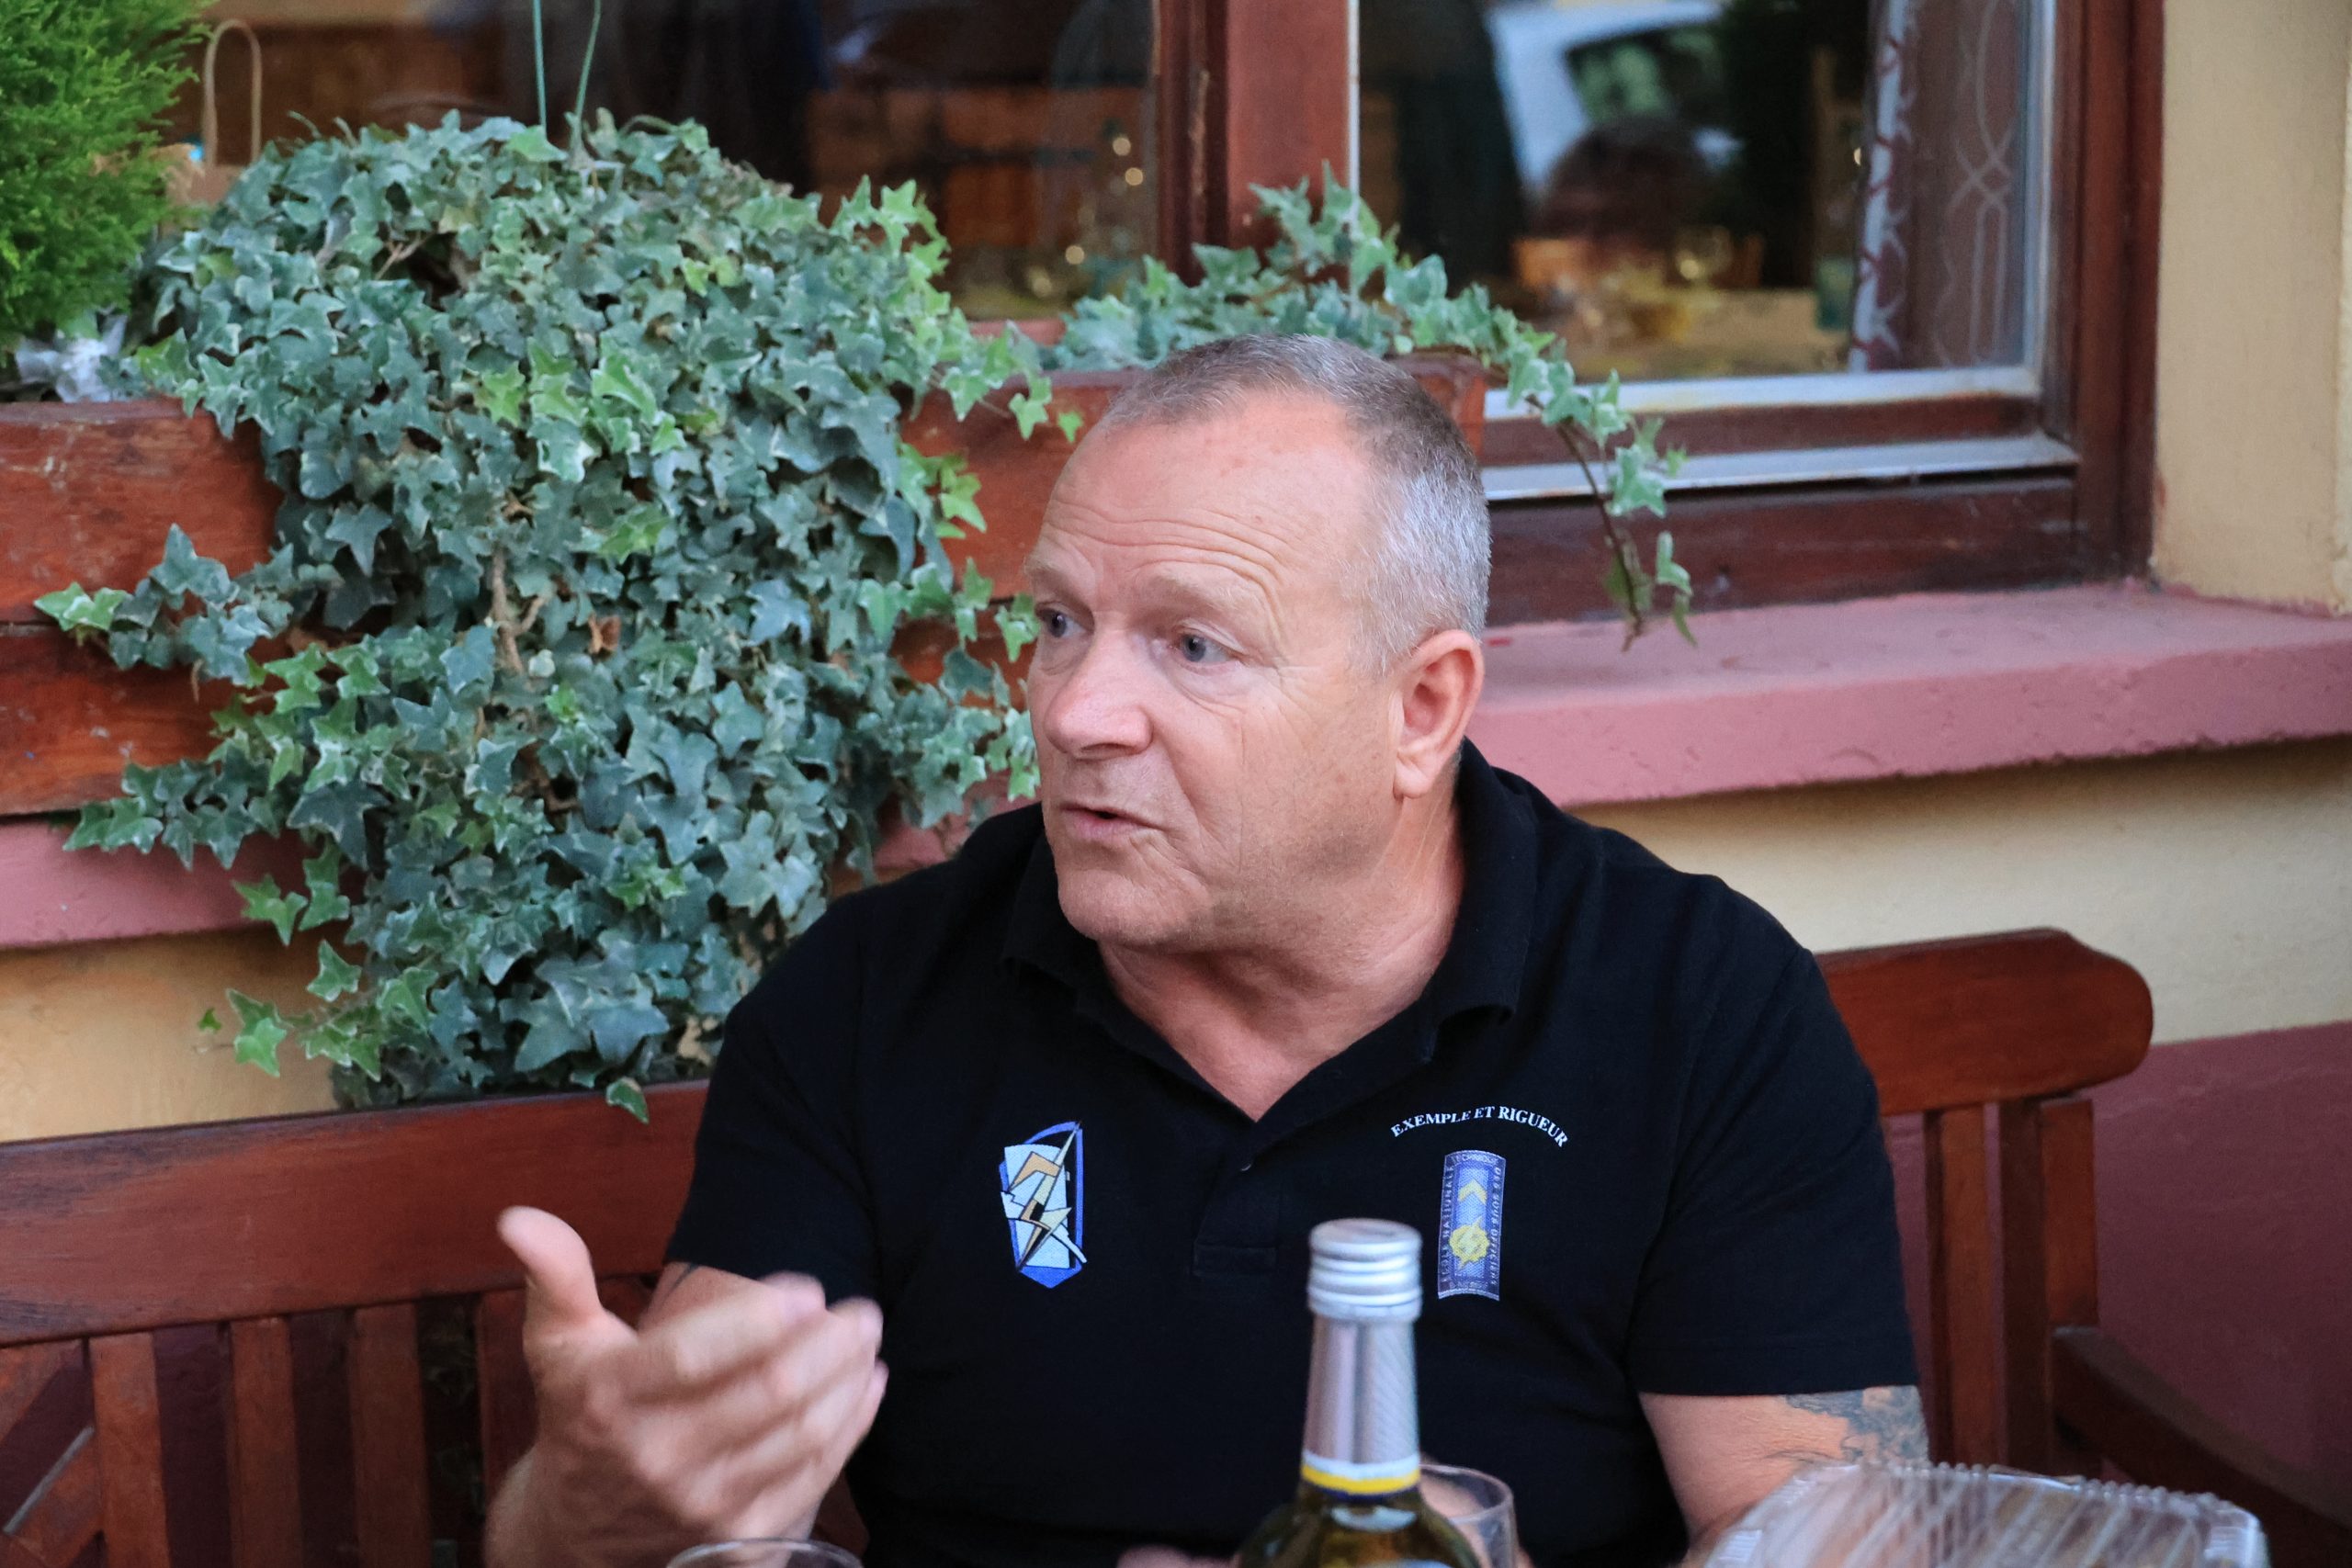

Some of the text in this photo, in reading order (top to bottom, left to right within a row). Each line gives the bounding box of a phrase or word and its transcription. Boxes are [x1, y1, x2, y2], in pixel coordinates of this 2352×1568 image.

[1391, 1106, 1568, 1147] EXEMPLE ET RIGUEUR
